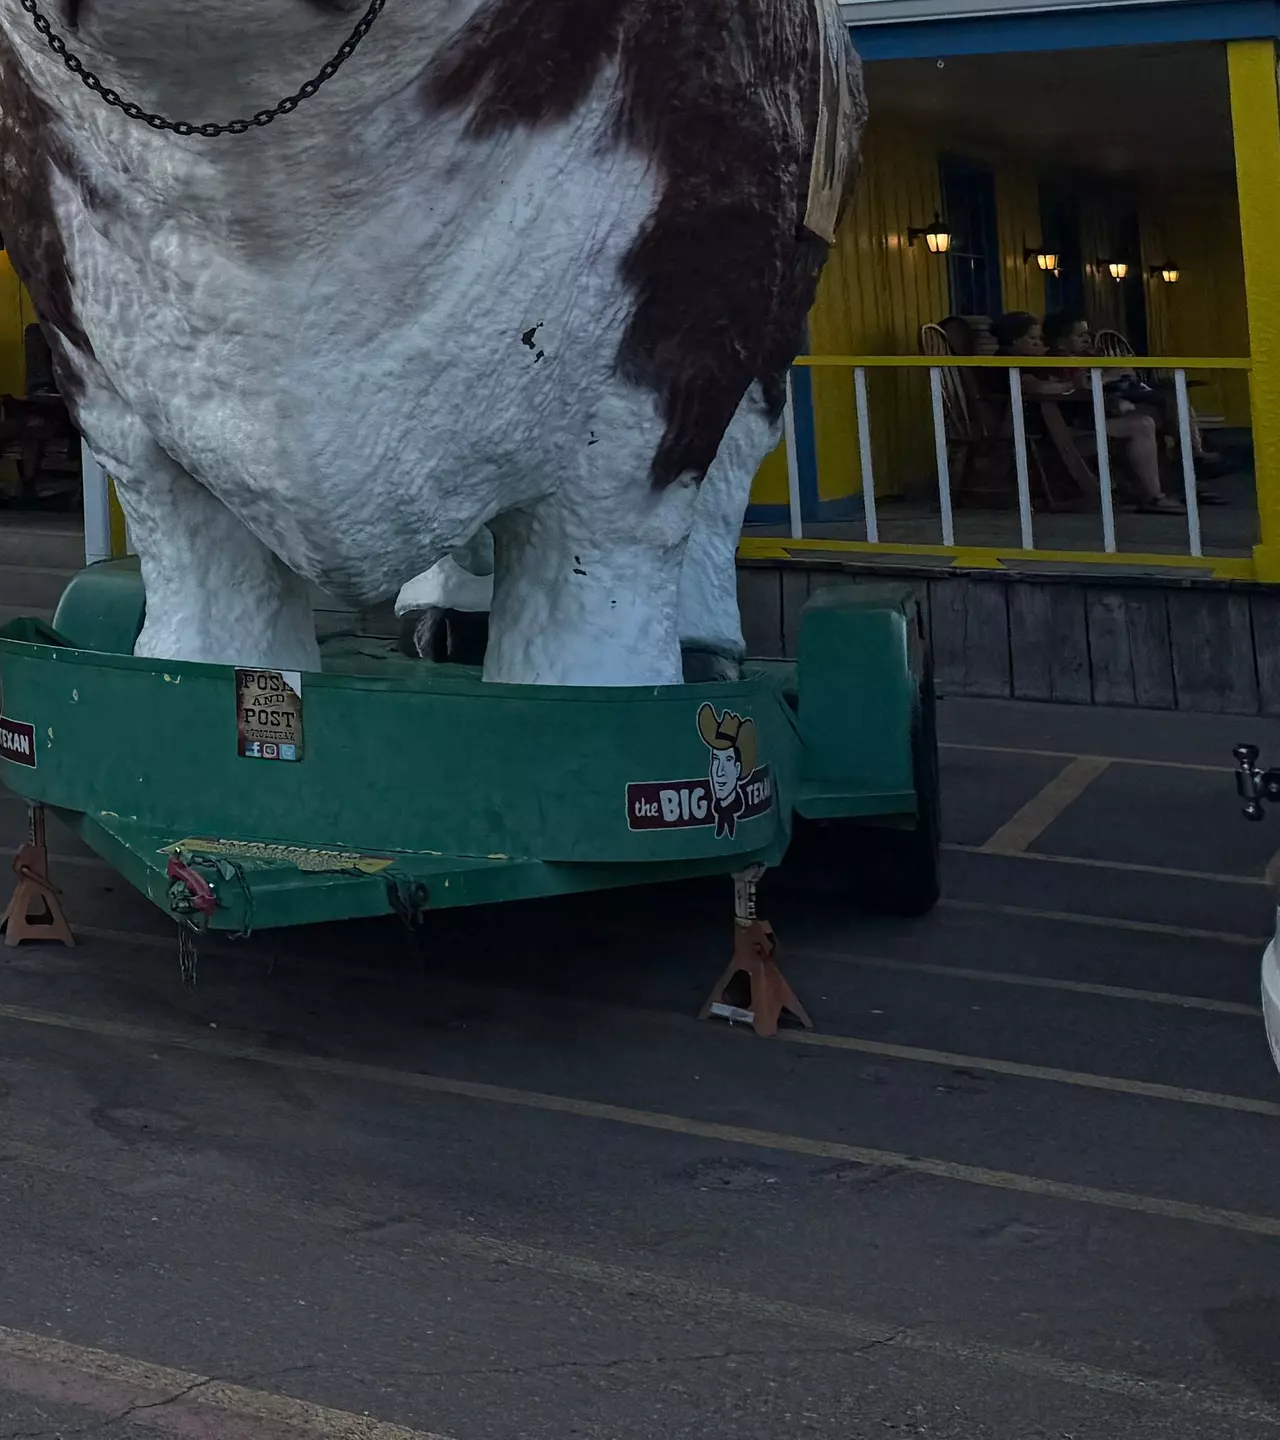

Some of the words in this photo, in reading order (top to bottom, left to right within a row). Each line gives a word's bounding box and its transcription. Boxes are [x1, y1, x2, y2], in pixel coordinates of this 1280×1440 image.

[252, 694, 285, 706] AND
[244, 708, 295, 728] POST
[634, 797, 659, 817] the
[659, 787, 708, 822] BIG
